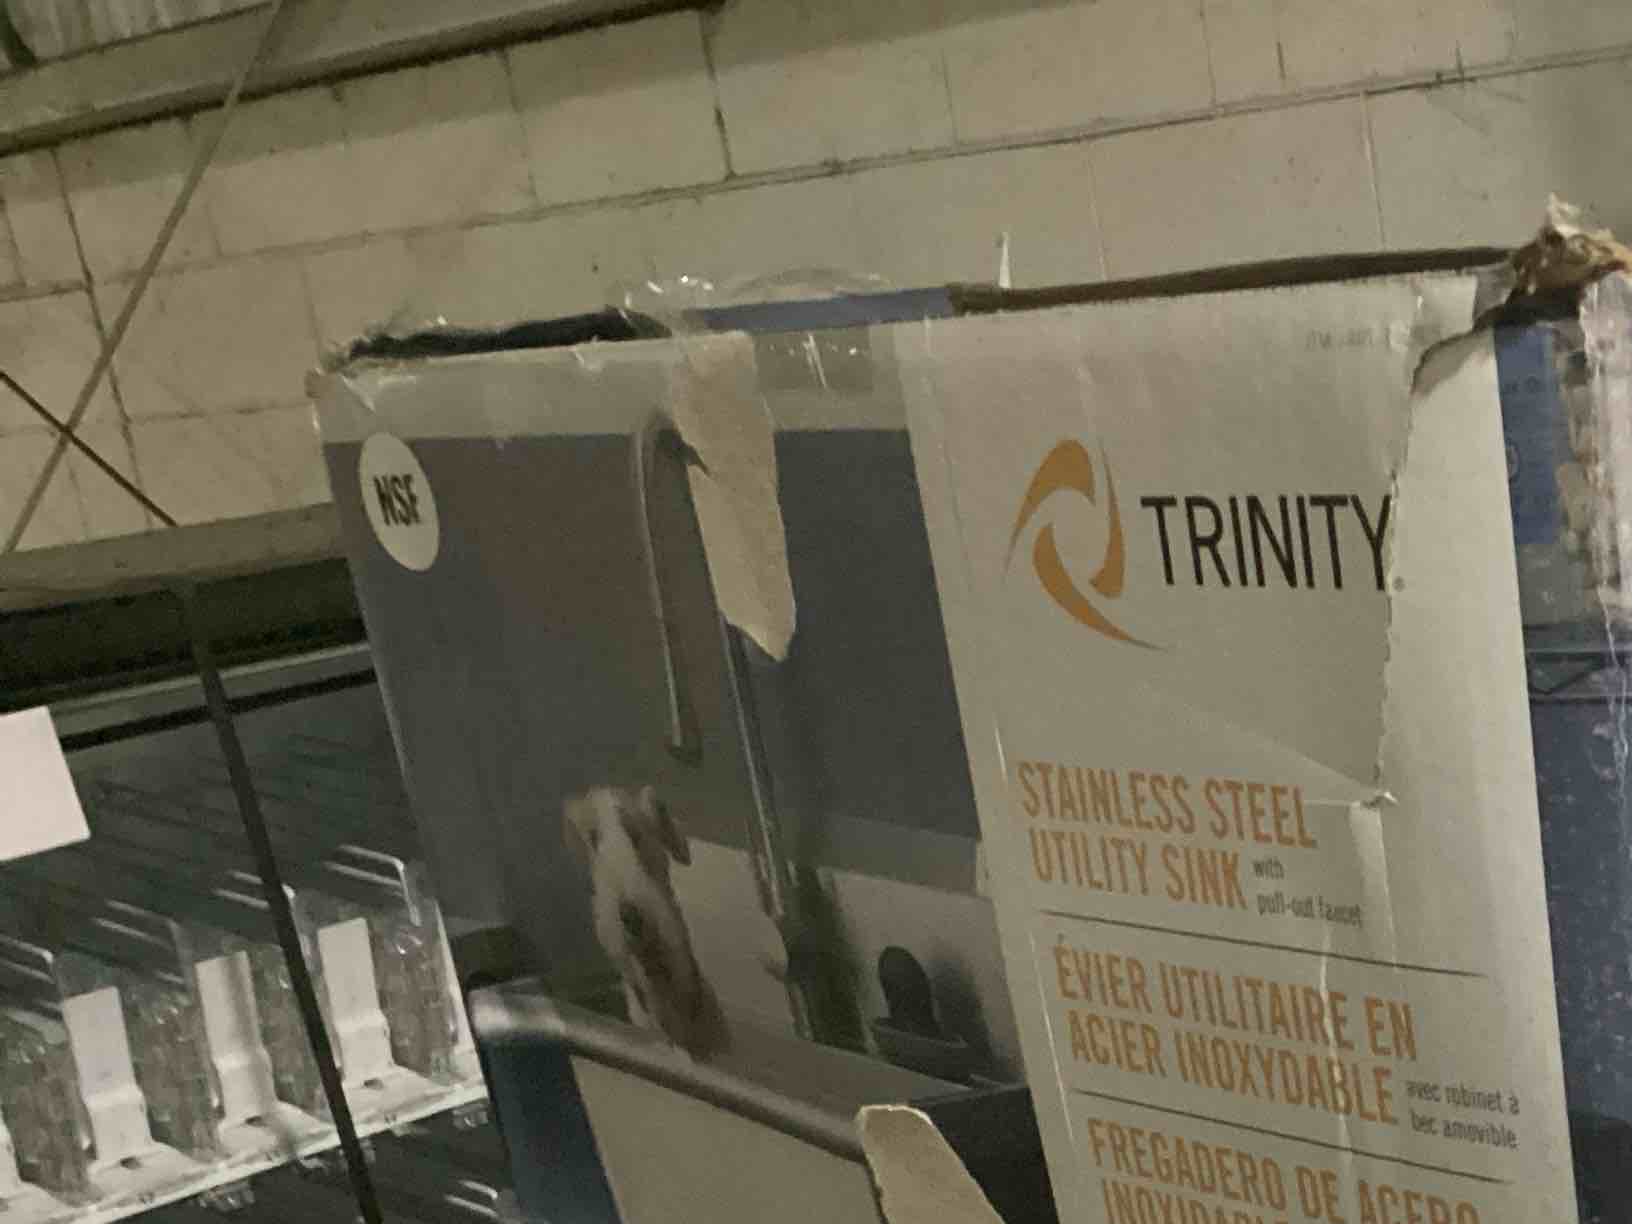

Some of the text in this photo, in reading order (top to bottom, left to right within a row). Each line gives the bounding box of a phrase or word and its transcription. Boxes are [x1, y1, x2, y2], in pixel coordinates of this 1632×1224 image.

[373, 474, 420, 526] NSF
[1140, 494, 1392, 592] TRINITY
[1016, 761, 1318, 849] STAINLESS STEEL
[1028, 828, 1285, 910] UTILITY SINK with
[1053, 933, 1418, 1061] ÉVIER UTILITAIRE EN
[1067, 1009, 1168, 1078] ACIER
[1173, 1029, 1399, 1126] INOXYDABLE
[1404, 1079, 1441, 1103] avec
[1087, 1118, 1288, 1213] FREGADERO
[1295, 1164, 1347, 1224] DE
